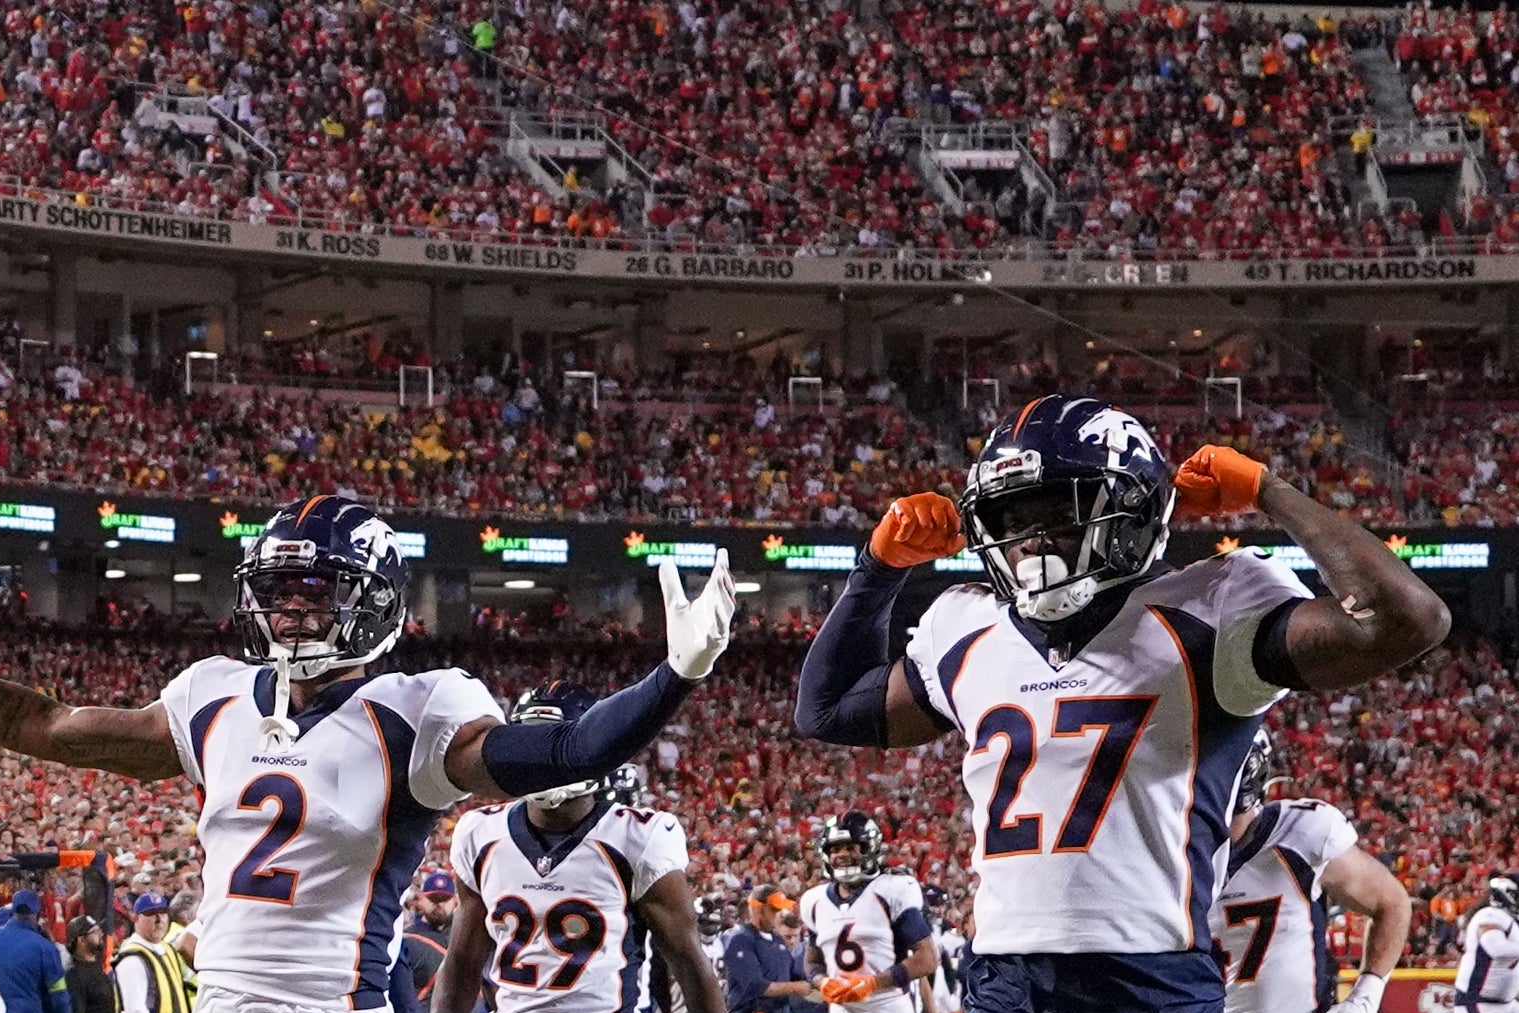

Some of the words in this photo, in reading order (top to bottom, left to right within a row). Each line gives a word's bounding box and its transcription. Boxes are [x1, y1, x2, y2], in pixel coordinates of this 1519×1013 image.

[46, 204, 232, 242] SCHOTTENHEIMER
[297, 231, 315, 250] K.
[322, 234, 380, 257] ROSS
[483, 247, 577, 270] SHIELDS
[682, 258, 794, 279] BARBARO
[868, 262, 887, 280] P.
[1245, 266, 1271, 281] 49
[1305, 260, 1476, 281] RICHARDSON
[101, 513, 176, 531] DRAFTKINGS
[482, 537, 568, 553] DRAFTKINGS
[627, 542, 716, 558] DRAFTKINGS
[765, 545, 856, 559] DRAFTKINGS
[502, 549, 567, 563] SPORTSBOOK
[786, 556, 855, 570] SPORTSBOOK
[1410, 556, 1489, 568] SPORTSBOOK
[1020, 679, 1088, 692] BRONCOS
[251, 755, 308, 767] BRONCOS
[971, 694, 1161, 860] 27
[227, 772, 307, 906] 2
[491, 894, 607, 991] 29
[834, 922, 865, 972] 6
